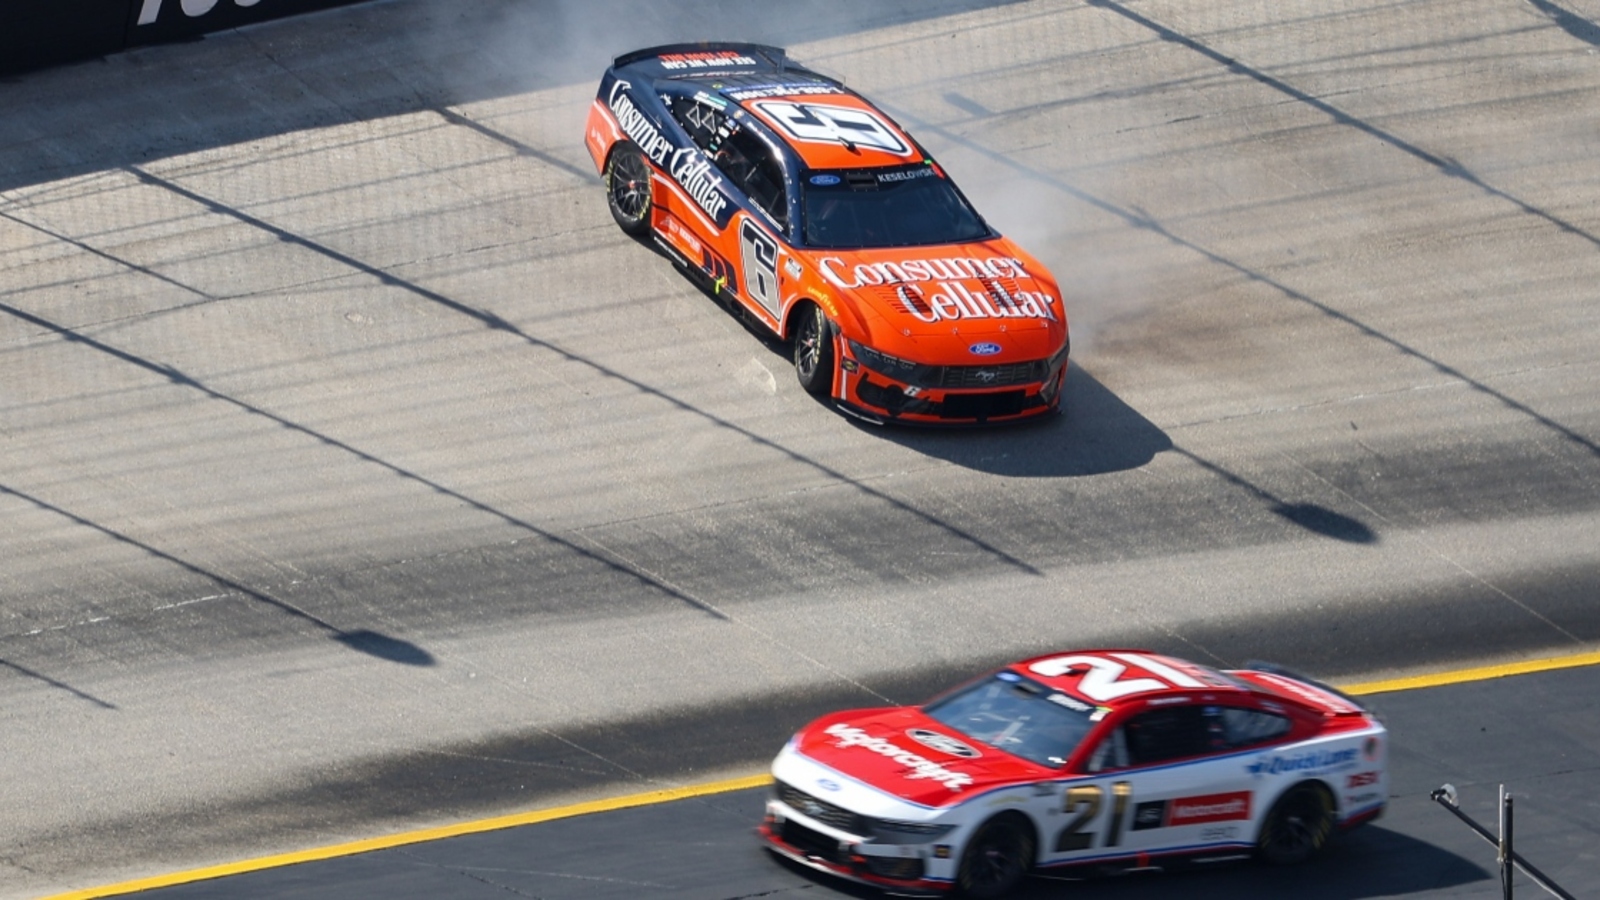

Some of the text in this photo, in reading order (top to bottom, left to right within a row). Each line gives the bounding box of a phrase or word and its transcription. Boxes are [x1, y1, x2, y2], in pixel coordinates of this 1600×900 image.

[609, 80, 674, 167] Consumer
[670, 147, 727, 222] Cellular
[741, 218, 781, 321] 6
[819, 256, 1031, 289] Consumer
[896, 280, 1058, 323] Cellular
[973, 342, 997, 355] Ford
[1028, 653, 1209, 702] 21
[1055, 780, 1132, 852] 21
